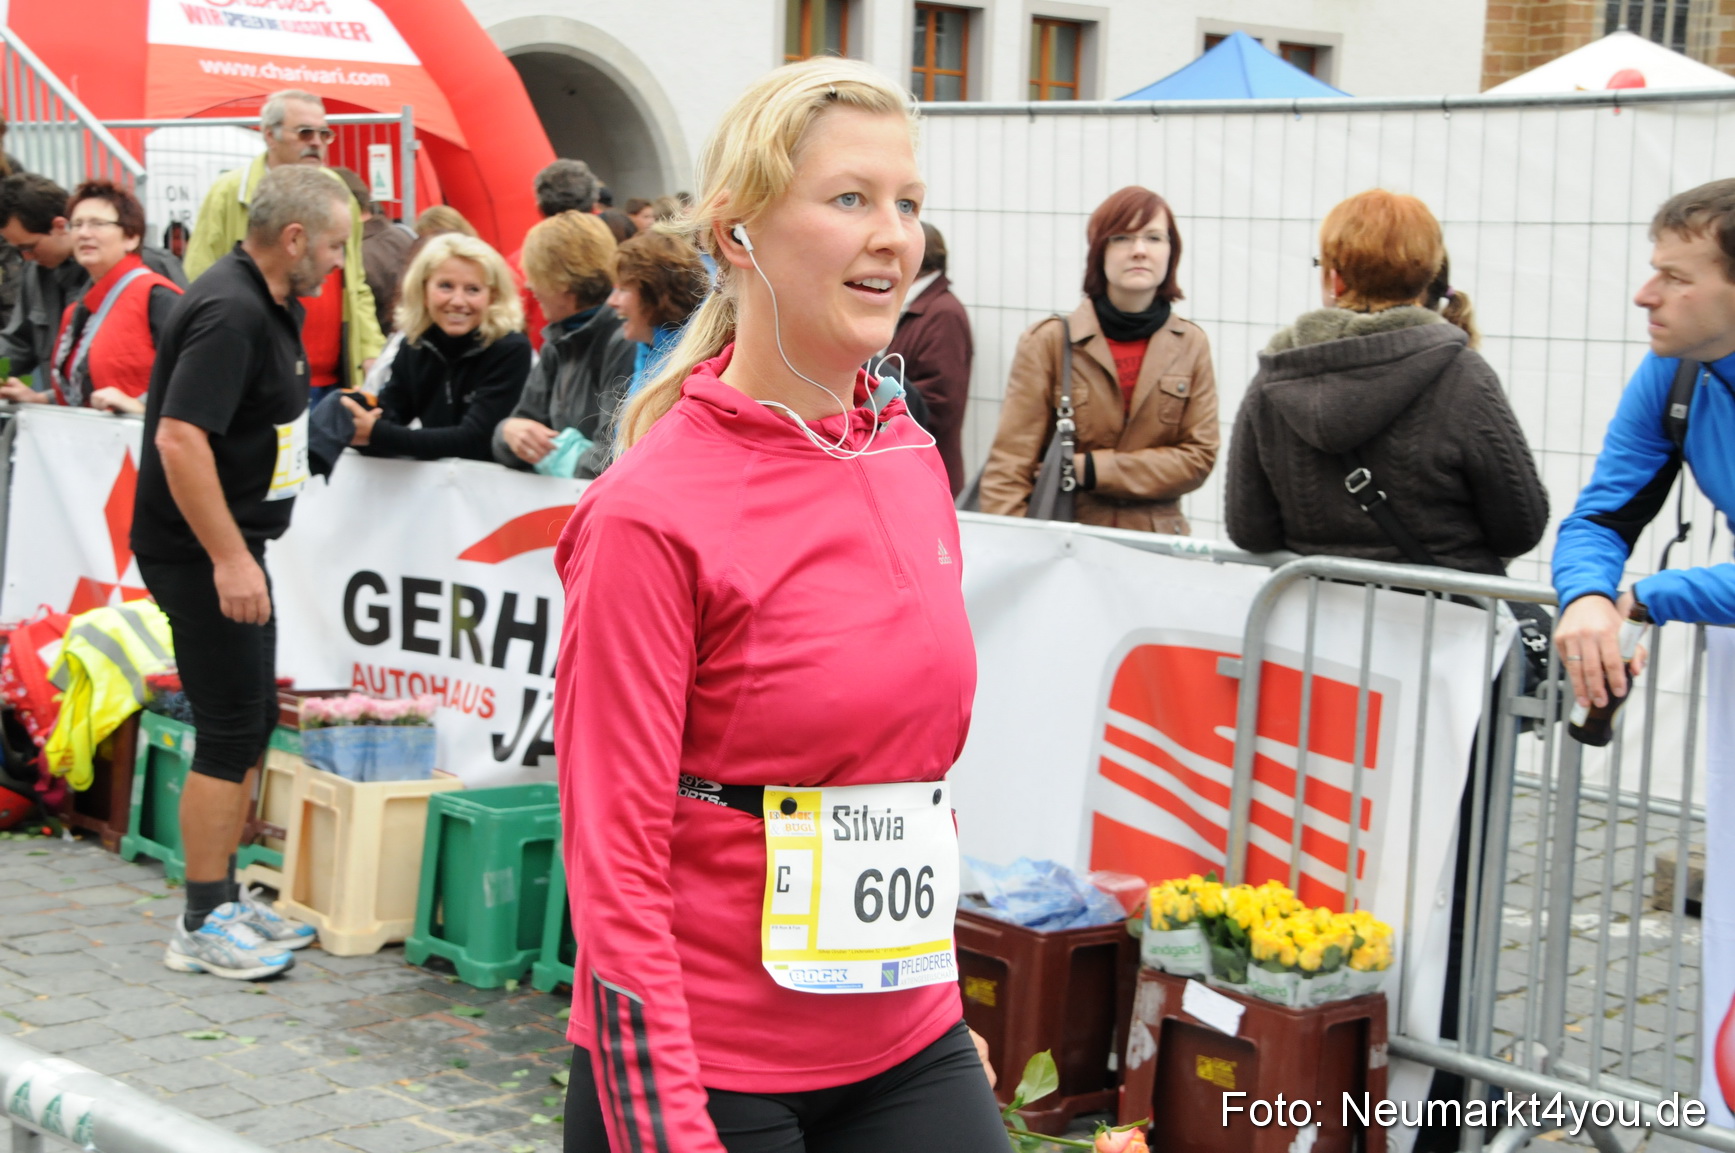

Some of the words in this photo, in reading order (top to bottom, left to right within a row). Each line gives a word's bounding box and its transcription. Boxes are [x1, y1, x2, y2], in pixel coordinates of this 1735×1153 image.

[198, 58, 391, 87] www.charivari.com
[166, 185, 190, 202] ON
[343, 569, 557, 679] GERH
[352, 660, 496, 720] AUTOHAUS
[832, 804, 904, 841] Silvia
[776, 865, 791, 893] C
[854, 865, 935, 923] 606
[789, 968, 849, 983] BOCK
[901, 952, 954, 976] PFLEIDERER
